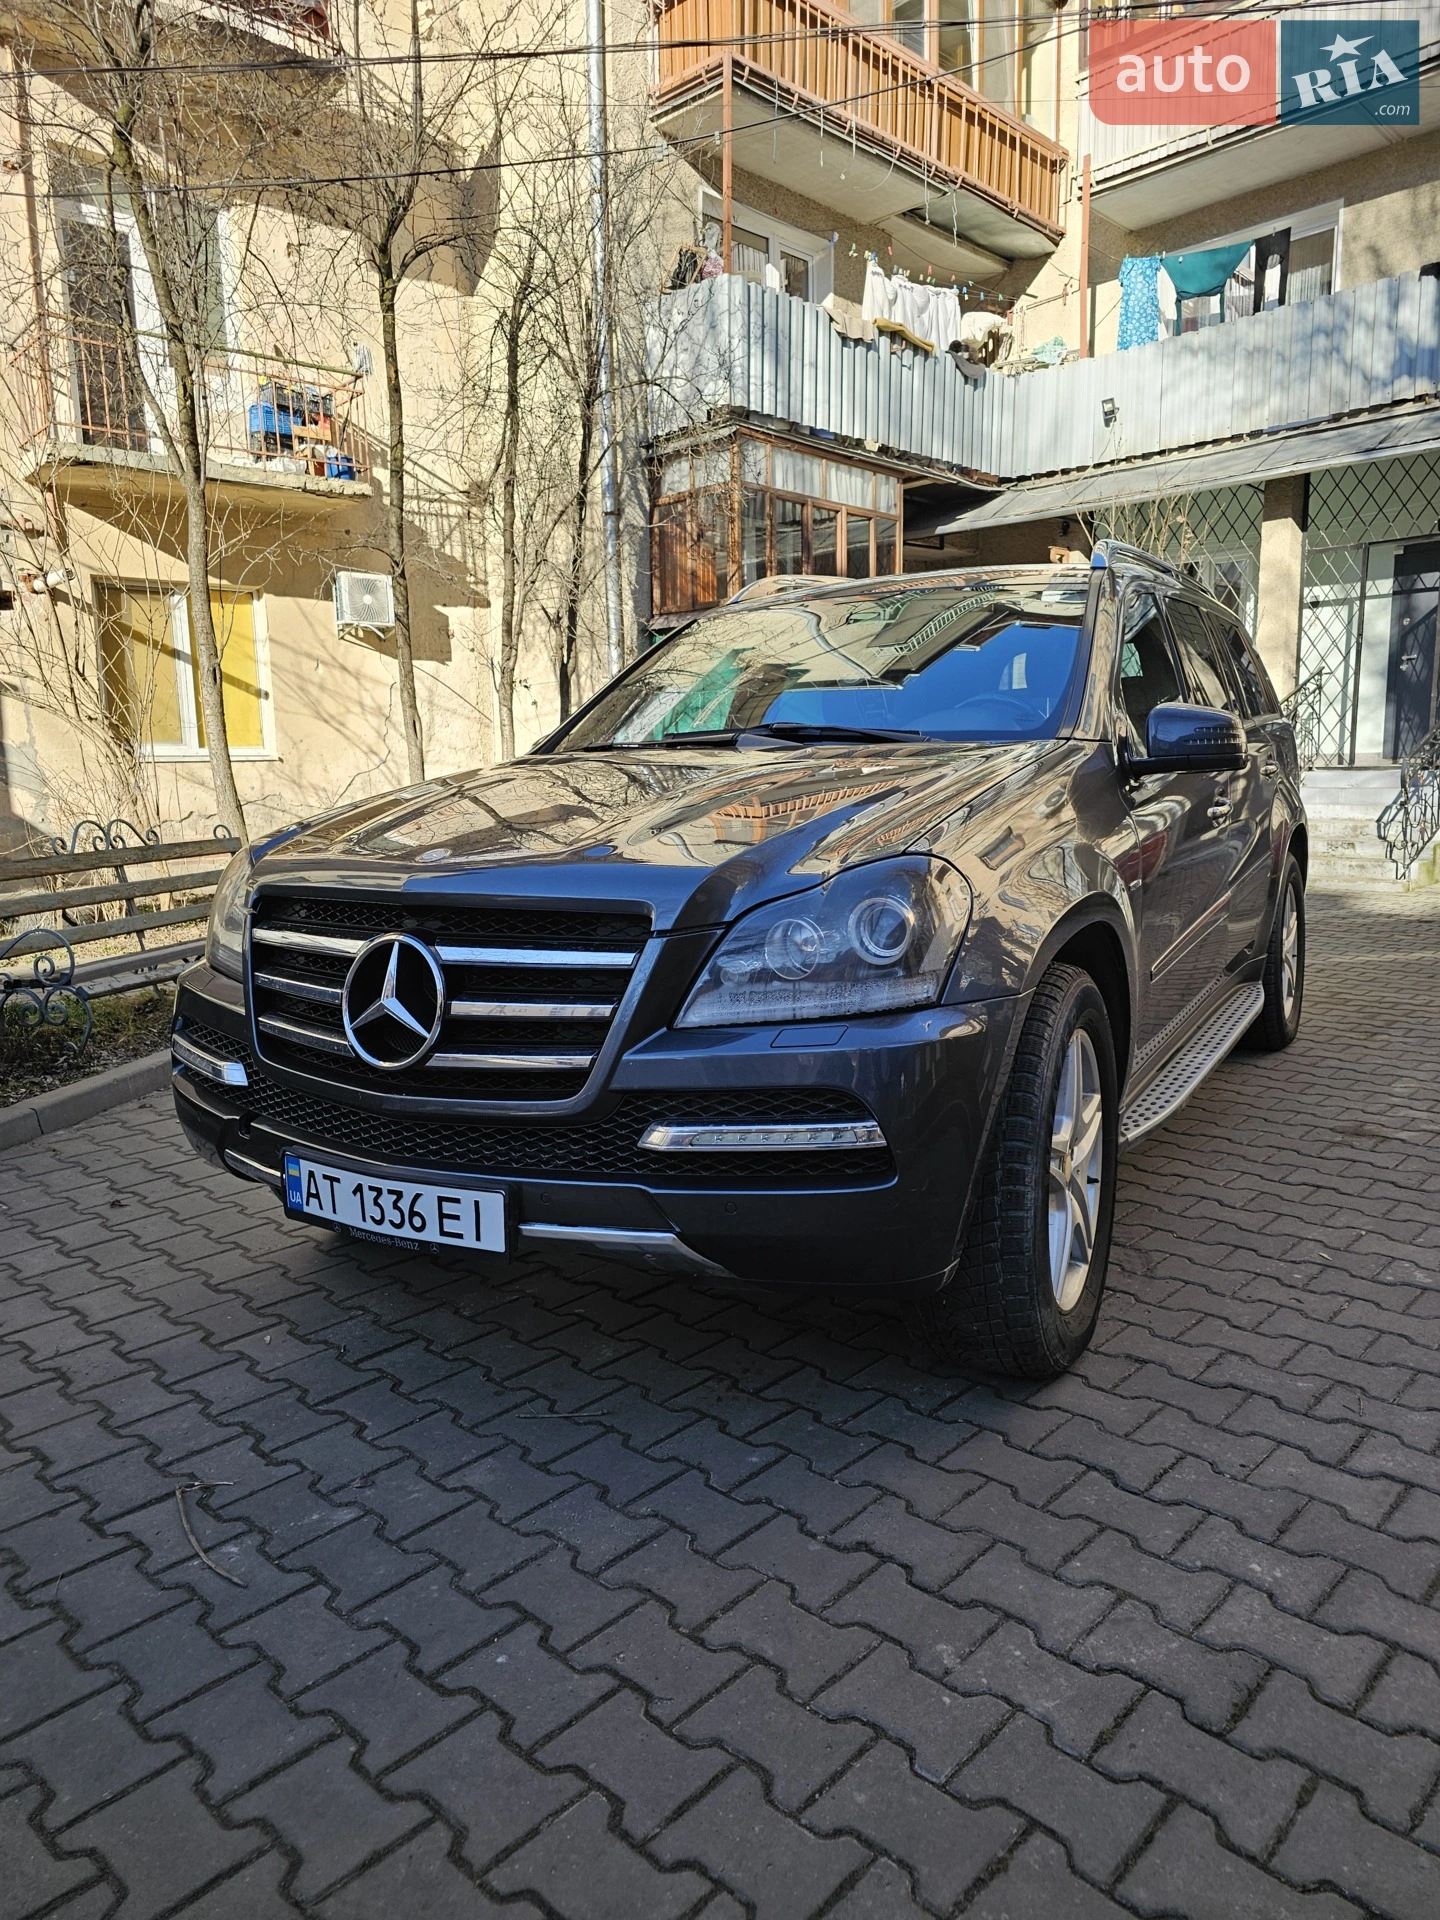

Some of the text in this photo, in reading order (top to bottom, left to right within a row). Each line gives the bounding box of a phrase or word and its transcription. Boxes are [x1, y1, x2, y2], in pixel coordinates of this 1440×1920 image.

[289, 1190, 302, 1205] UA
[305, 1169, 481, 1242] AT 1336 EI
[349, 1226, 420, 1251] Mercedes-Benz
